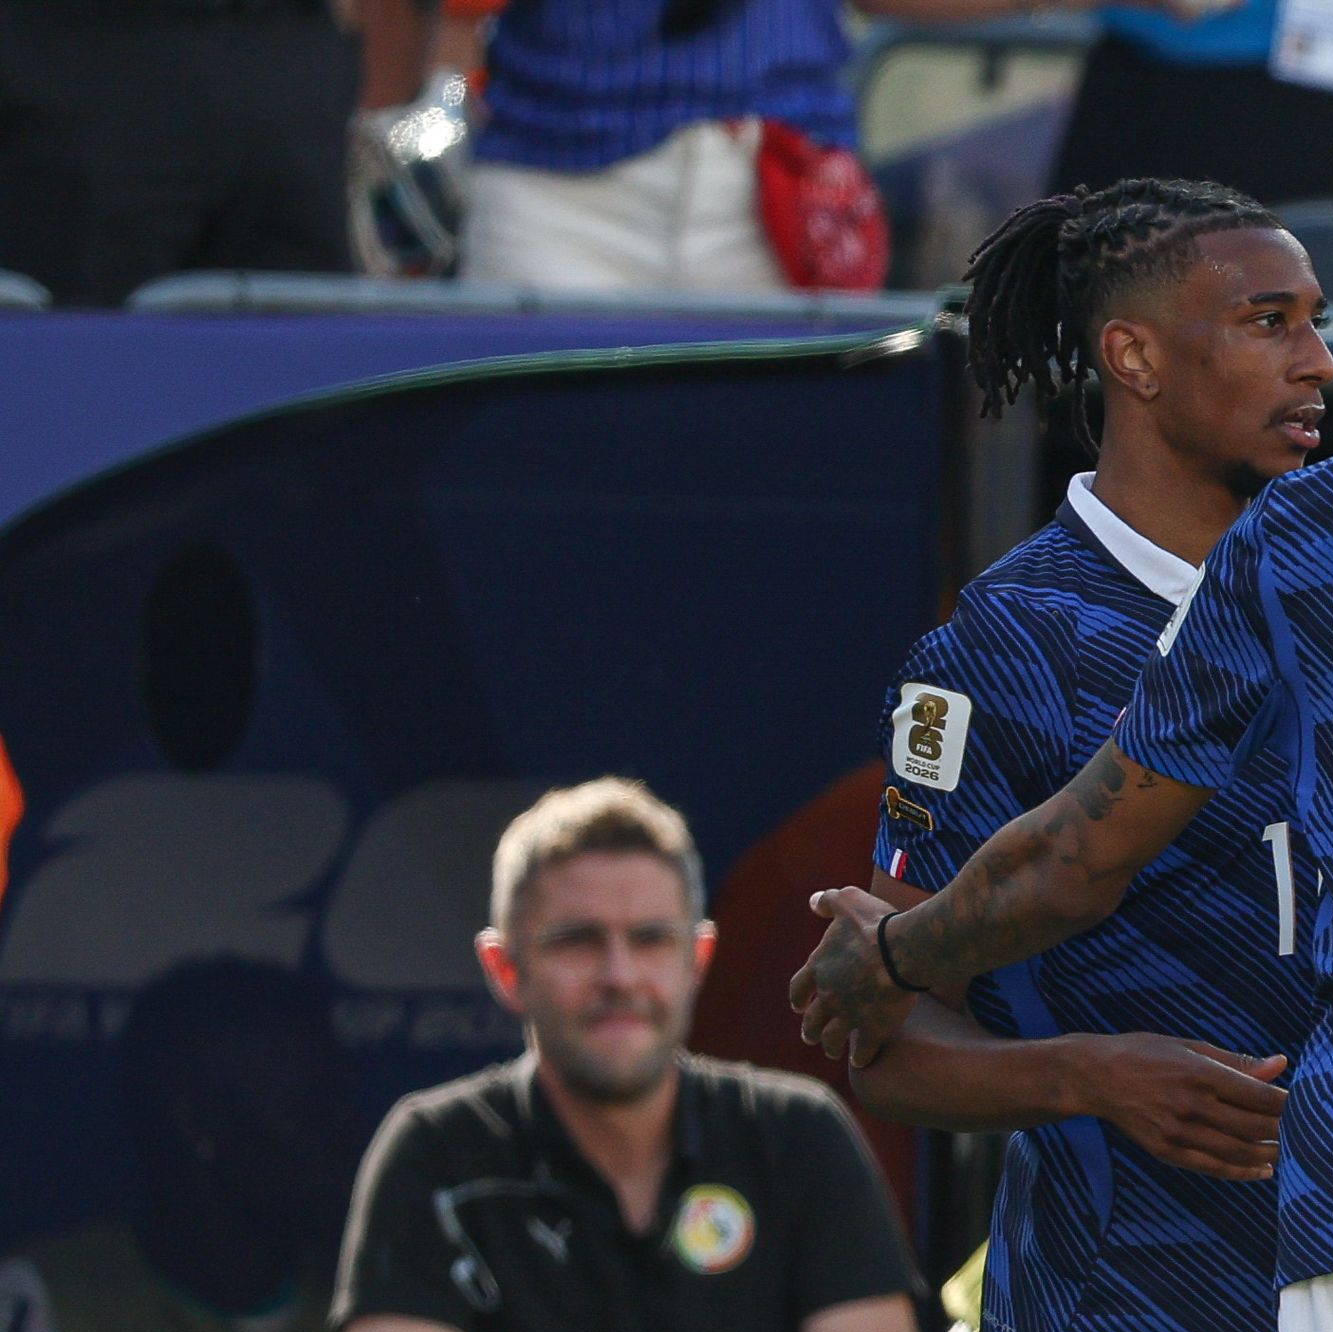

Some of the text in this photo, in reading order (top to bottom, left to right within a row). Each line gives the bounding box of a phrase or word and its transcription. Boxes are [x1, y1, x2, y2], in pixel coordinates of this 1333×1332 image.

[915, 743, 933, 755] FIFA
[906, 756, 941, 771] WORLD CUP
[905, 763, 940, 781] 2026
